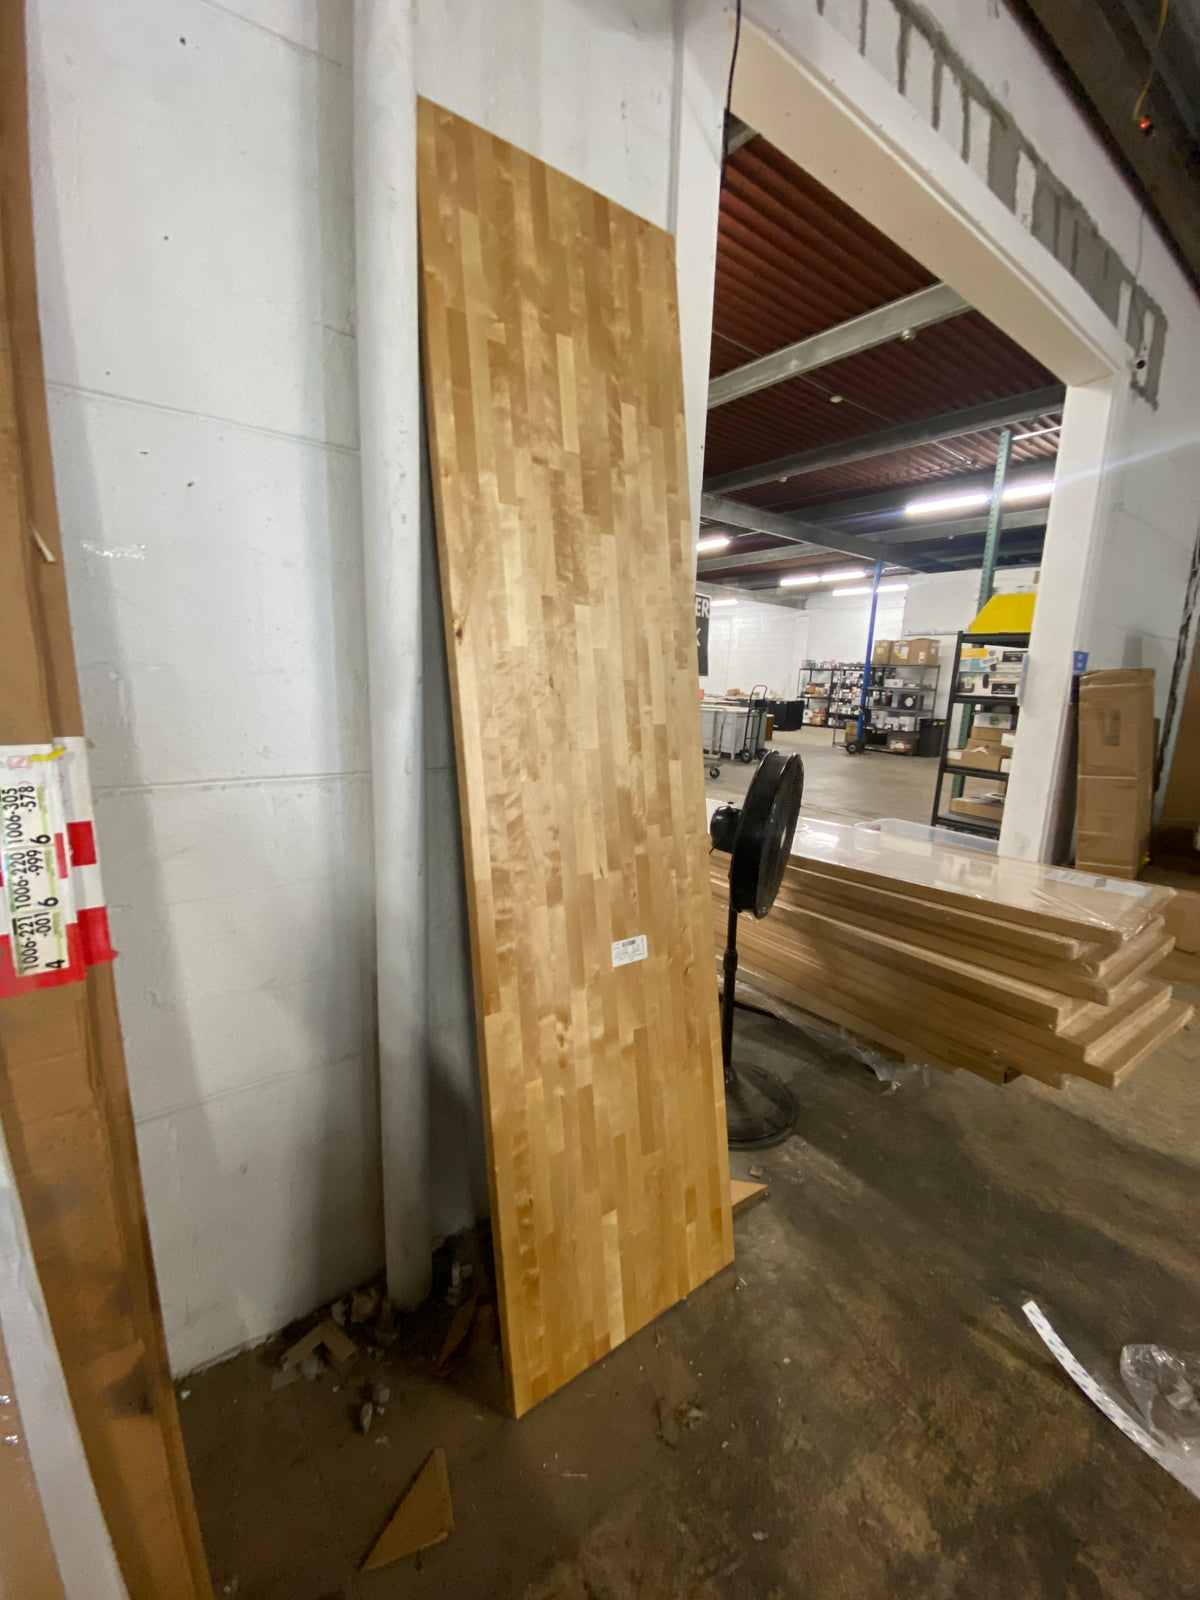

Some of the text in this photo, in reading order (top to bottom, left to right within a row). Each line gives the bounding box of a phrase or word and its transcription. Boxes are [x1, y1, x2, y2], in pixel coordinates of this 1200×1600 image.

[29, 834, 51, 844] 6
[37, 897, 59, 907] 6
[45, 959, 65, 969] 4
